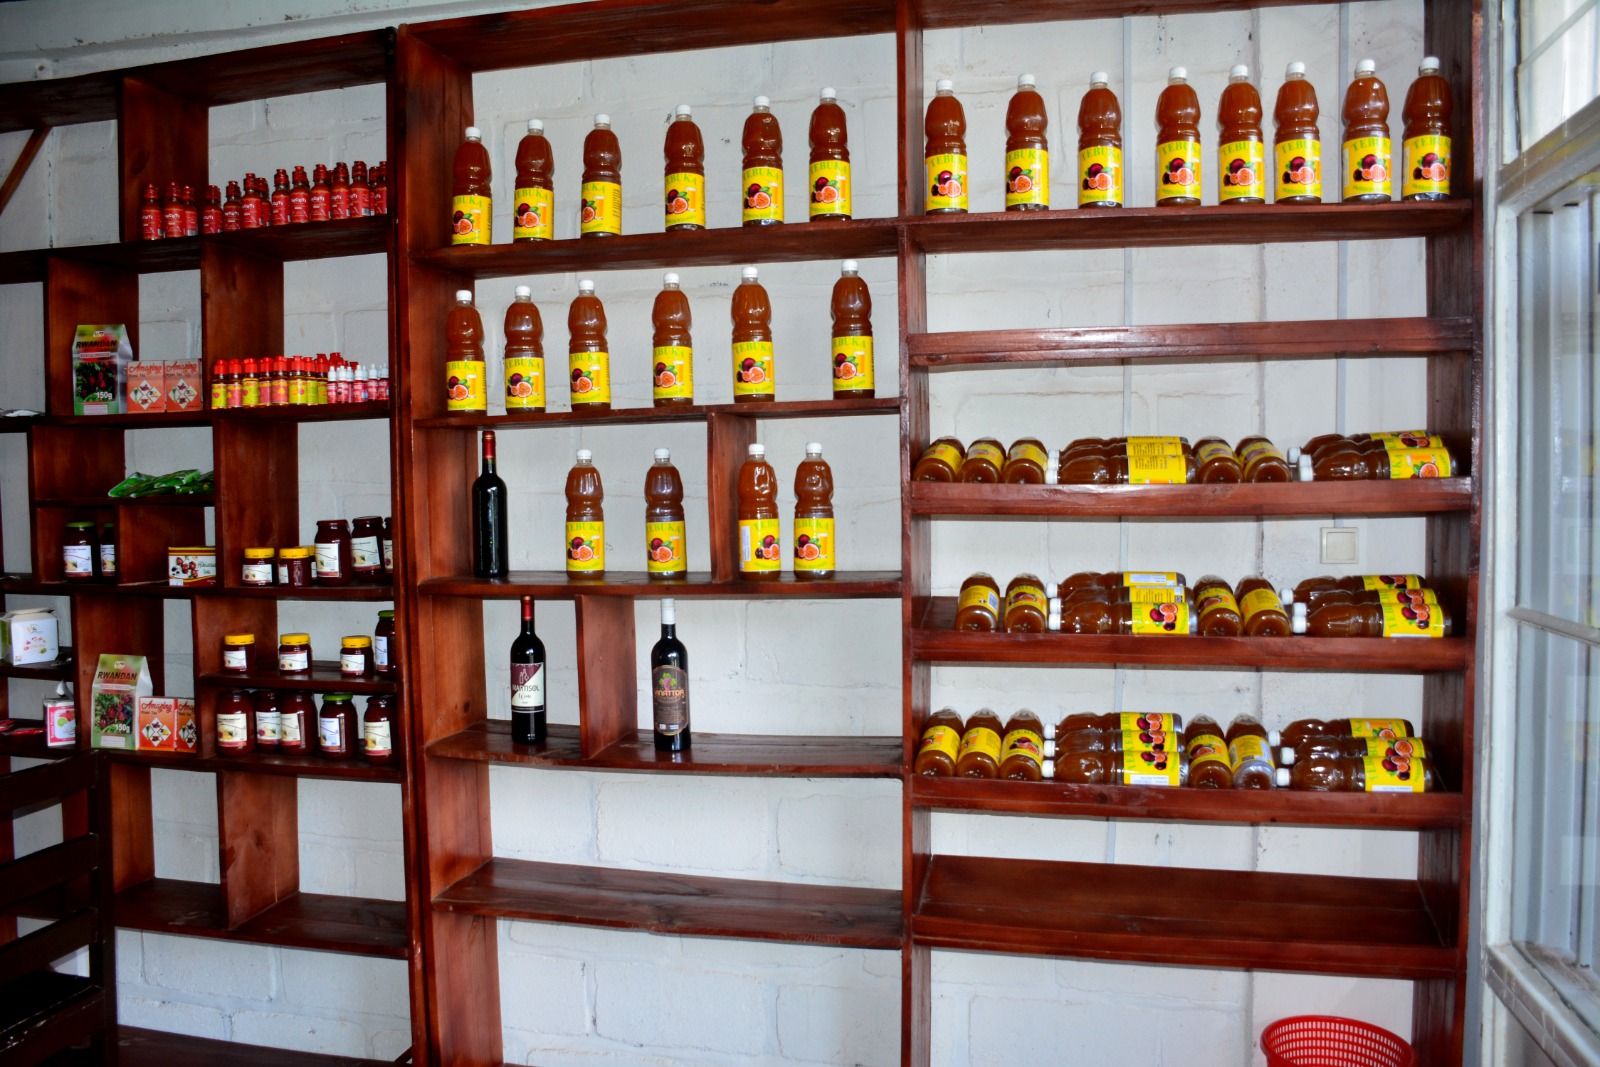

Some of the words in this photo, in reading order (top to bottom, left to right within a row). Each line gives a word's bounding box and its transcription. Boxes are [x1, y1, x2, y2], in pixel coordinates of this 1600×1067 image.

[76, 340, 118, 350] RWANDAN
[96, 391, 113, 400] 150g
[97, 671, 138, 680] RWANDAN
[115, 723, 130, 733] 150g
